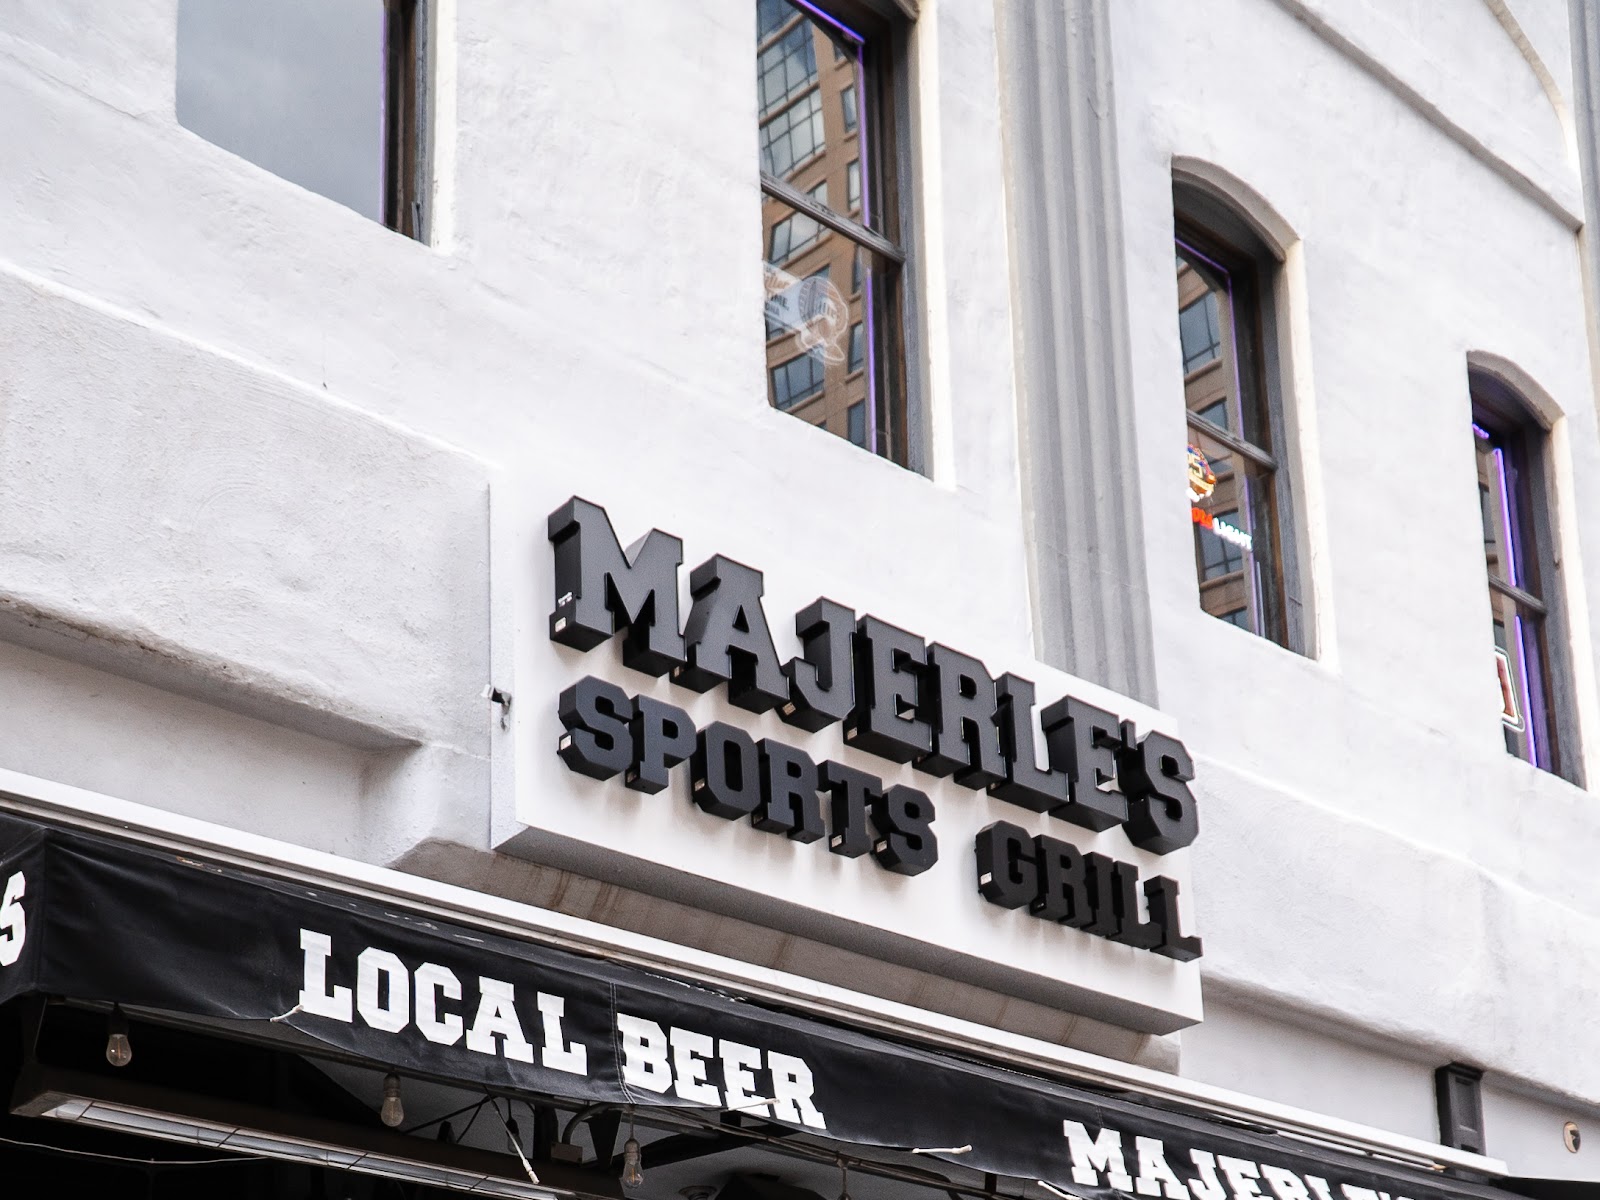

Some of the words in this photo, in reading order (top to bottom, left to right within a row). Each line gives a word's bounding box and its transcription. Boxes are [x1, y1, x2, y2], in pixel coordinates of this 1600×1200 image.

[548, 495, 1200, 856] MAJERLE'S
[557, 674, 938, 877] SPORTS
[974, 819, 1203, 962] GRILL
[298, 928, 588, 1076] LOCAL
[616, 1012, 827, 1130] BEER
